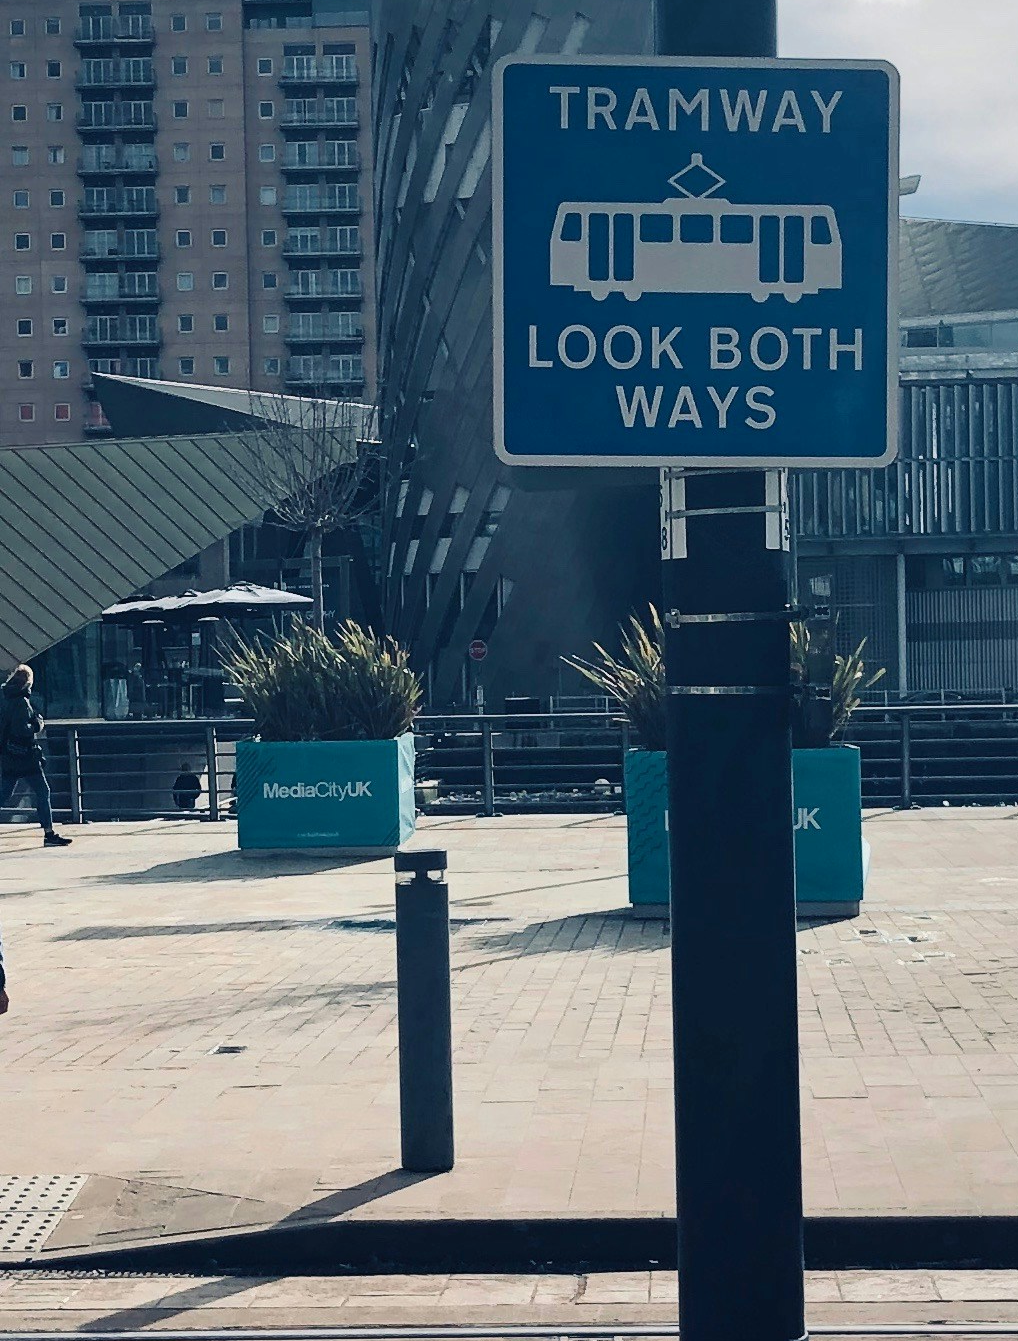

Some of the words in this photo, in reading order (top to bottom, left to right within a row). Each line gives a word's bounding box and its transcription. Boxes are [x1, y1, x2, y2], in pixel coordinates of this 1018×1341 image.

[550, 87, 842, 132] TRAMWAY
[529, 325, 683, 369] LOOK
[710, 327, 862, 370] BOTH
[616, 386, 775, 429] WAYS
[263, 781, 372, 801] MediaCityUK
